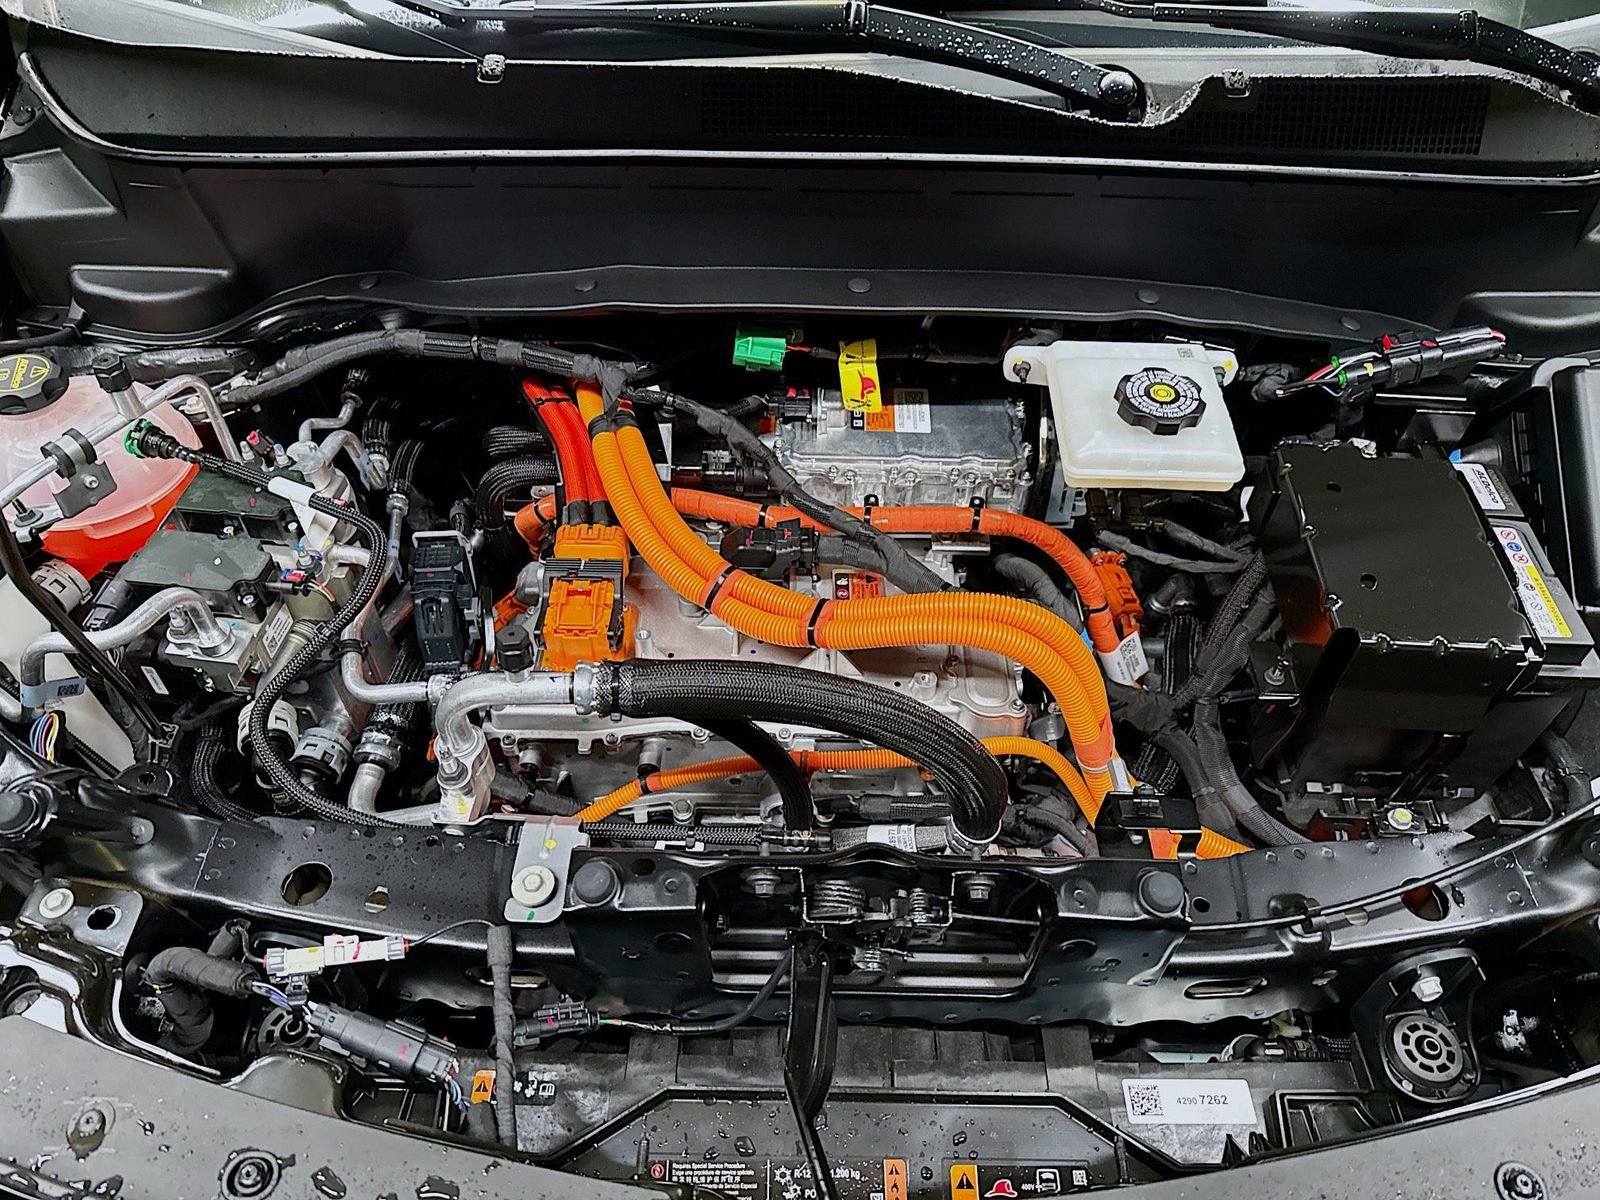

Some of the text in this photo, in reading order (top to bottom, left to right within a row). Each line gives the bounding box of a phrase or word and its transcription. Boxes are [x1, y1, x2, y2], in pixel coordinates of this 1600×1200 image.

[1176, 1094, 1229, 1105] 4290 7262
[691, 1162, 707, 1170] Special
[794, 1168, 811, 1179] R-12
[850, 1168, 860, 1180] kg
[740, 1182, 758, 1190] Especial
[804, 1188, 817, 1199] PO
